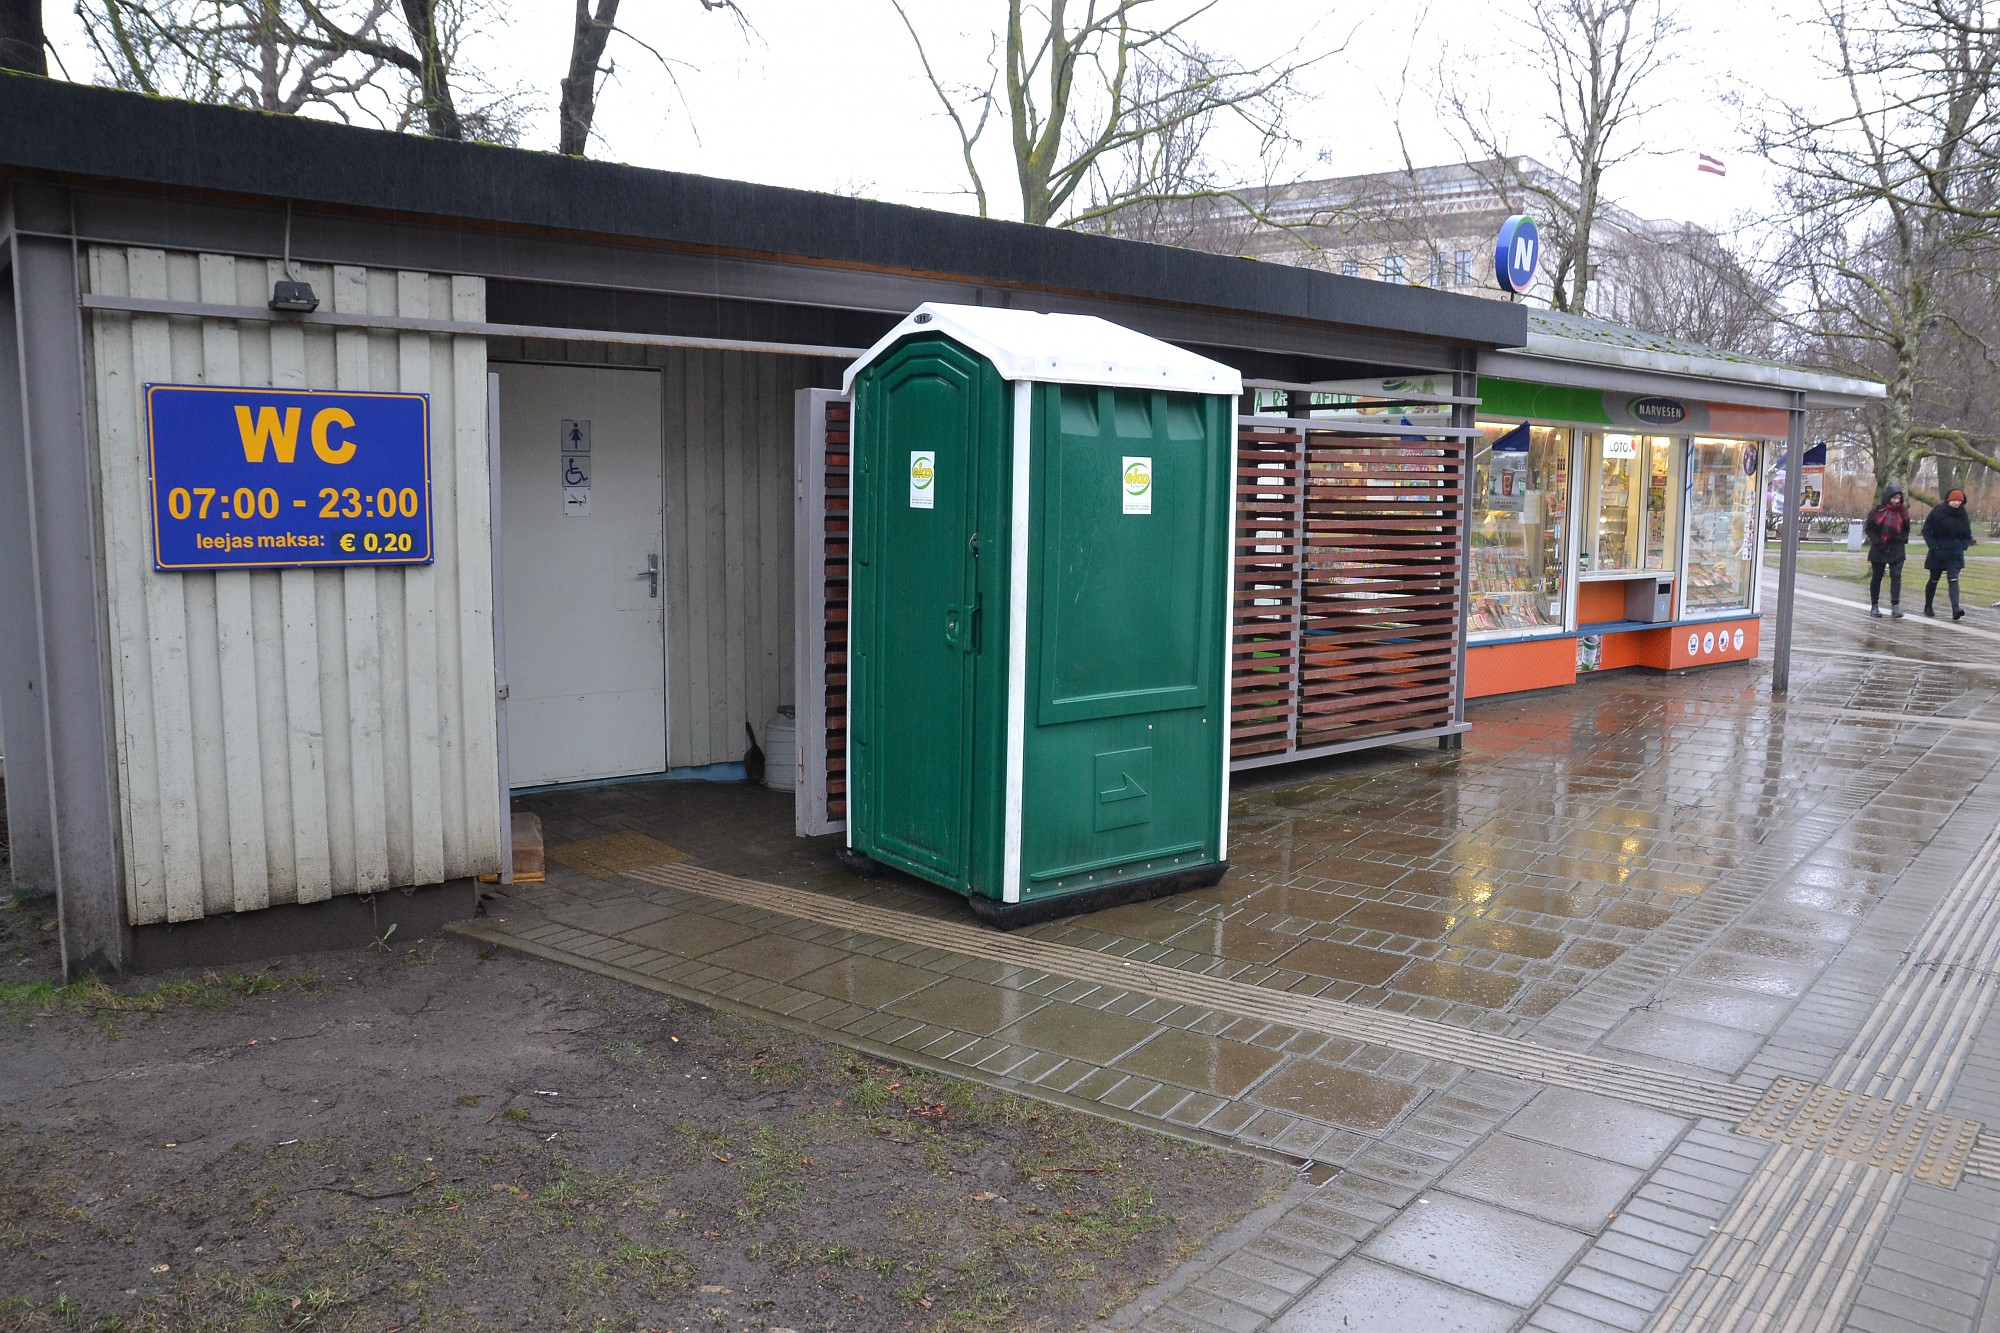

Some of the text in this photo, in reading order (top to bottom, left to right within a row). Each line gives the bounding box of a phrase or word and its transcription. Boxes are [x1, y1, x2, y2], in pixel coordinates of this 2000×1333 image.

[1514, 236, 1534, 272] N
[1639, 404, 1681, 418] NARVESEN
[233, 405, 357, 465] WC
[912, 462, 933, 478] eko
[1125, 467, 1150, 484] eko
[168, 487, 280, 520] 07:00
[318, 487, 419, 518] 23:00
[196, 531, 412, 553] Ieejas maksa: € 0,20
